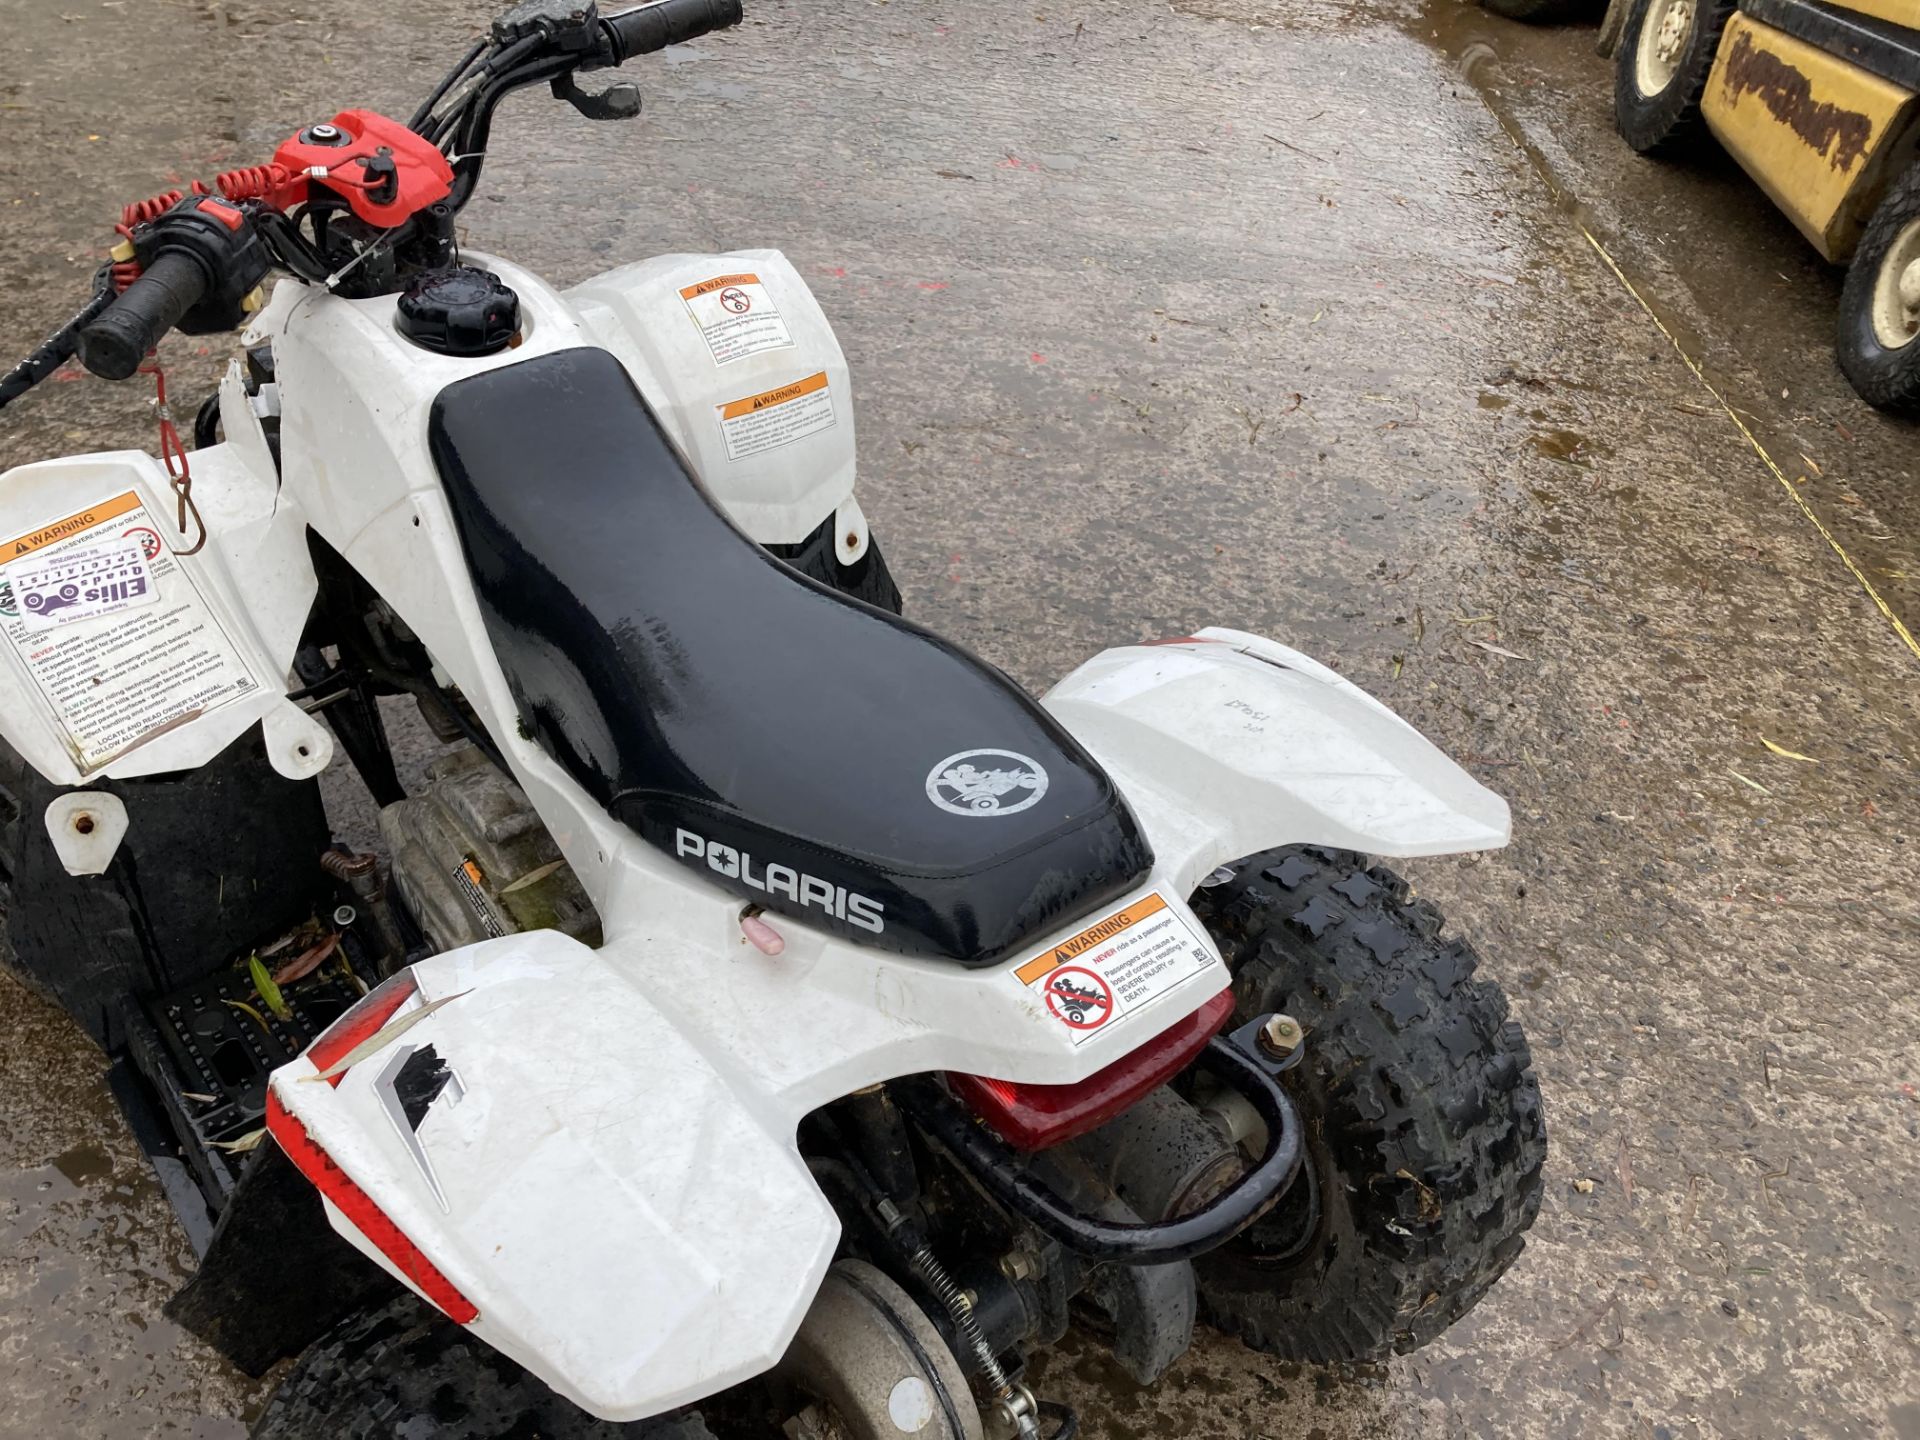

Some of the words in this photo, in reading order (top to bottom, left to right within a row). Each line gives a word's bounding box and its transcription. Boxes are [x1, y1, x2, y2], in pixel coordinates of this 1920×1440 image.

[734, 301, 742, 310] 6
[761, 385, 801, 405] WARNING
[29, 513, 95, 545] WARNING
[68, 533, 93, 547] SEVERE
[94, 522, 117, 536] INJURY
[124, 511, 146, 523] DEATH
[17, 552, 138, 587] SPECIALIST
[80, 566, 143, 586] Quads
[84, 577, 147, 603] Ellis
[30, 646, 54, 659] NEVER
[91, 739, 121, 756] FOLLOW
[121, 732, 134, 741] ALL
[135, 709, 184, 734] INSTRUCTIONS
[186, 702, 199, 710] AND
[98, 728, 126, 744] LOCATE
[126, 721, 142, 731] AND
[142, 711, 161, 723] READ
[162, 696, 193, 714] OWNER'S
[675, 827, 885, 934] POLARIS
[1065, 913, 1132, 954] WARNING
[1093, 948, 1117, 965] NEVER
[1116, 941, 1130, 952] ride
[1104, 955, 1141, 978] Passengers
[1140, 948, 1151, 958] can
[1150, 939, 1169, 952] cause
[1111, 975, 1125, 986] loss
[1124, 970, 1133, 979] of
[1155, 944, 1182, 964] resulting
[1180, 939, 1188, 948] in
[1117, 976, 1145, 995] SEVERE
[1144, 962, 1167, 981] INJURY
[1167, 958, 1176, 966] or
[1124, 986, 1150, 1003] DEATH.
